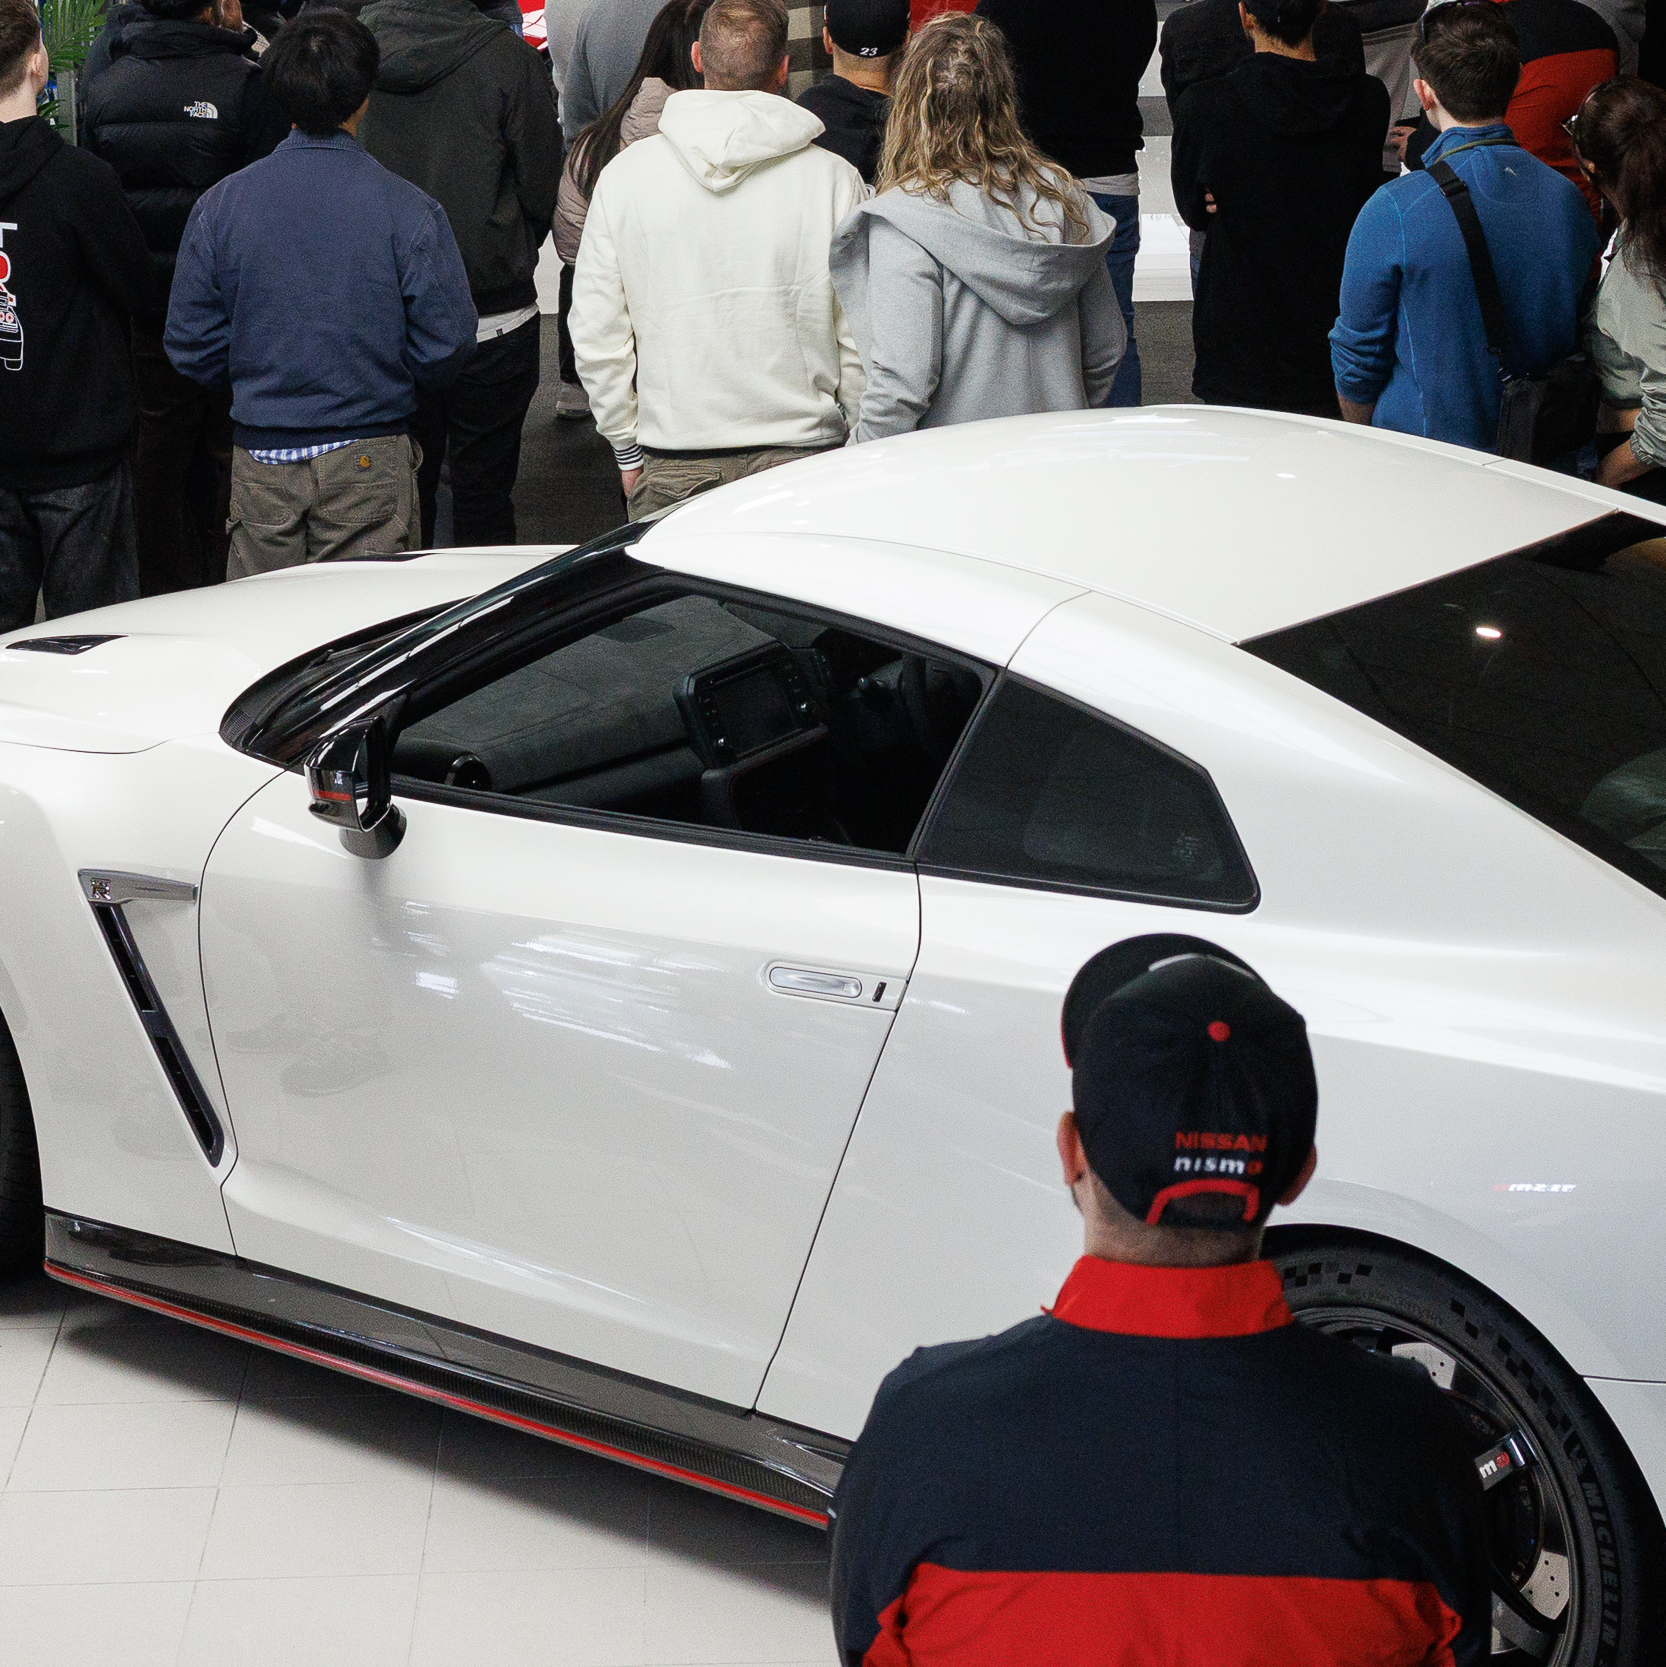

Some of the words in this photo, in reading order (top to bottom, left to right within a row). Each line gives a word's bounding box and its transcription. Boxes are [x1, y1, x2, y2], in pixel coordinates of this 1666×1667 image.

[859, 47, 878, 56] 23
[1174, 1131, 1268, 1152] NISSAN
[1173, 1156, 1264, 1175] nismo
